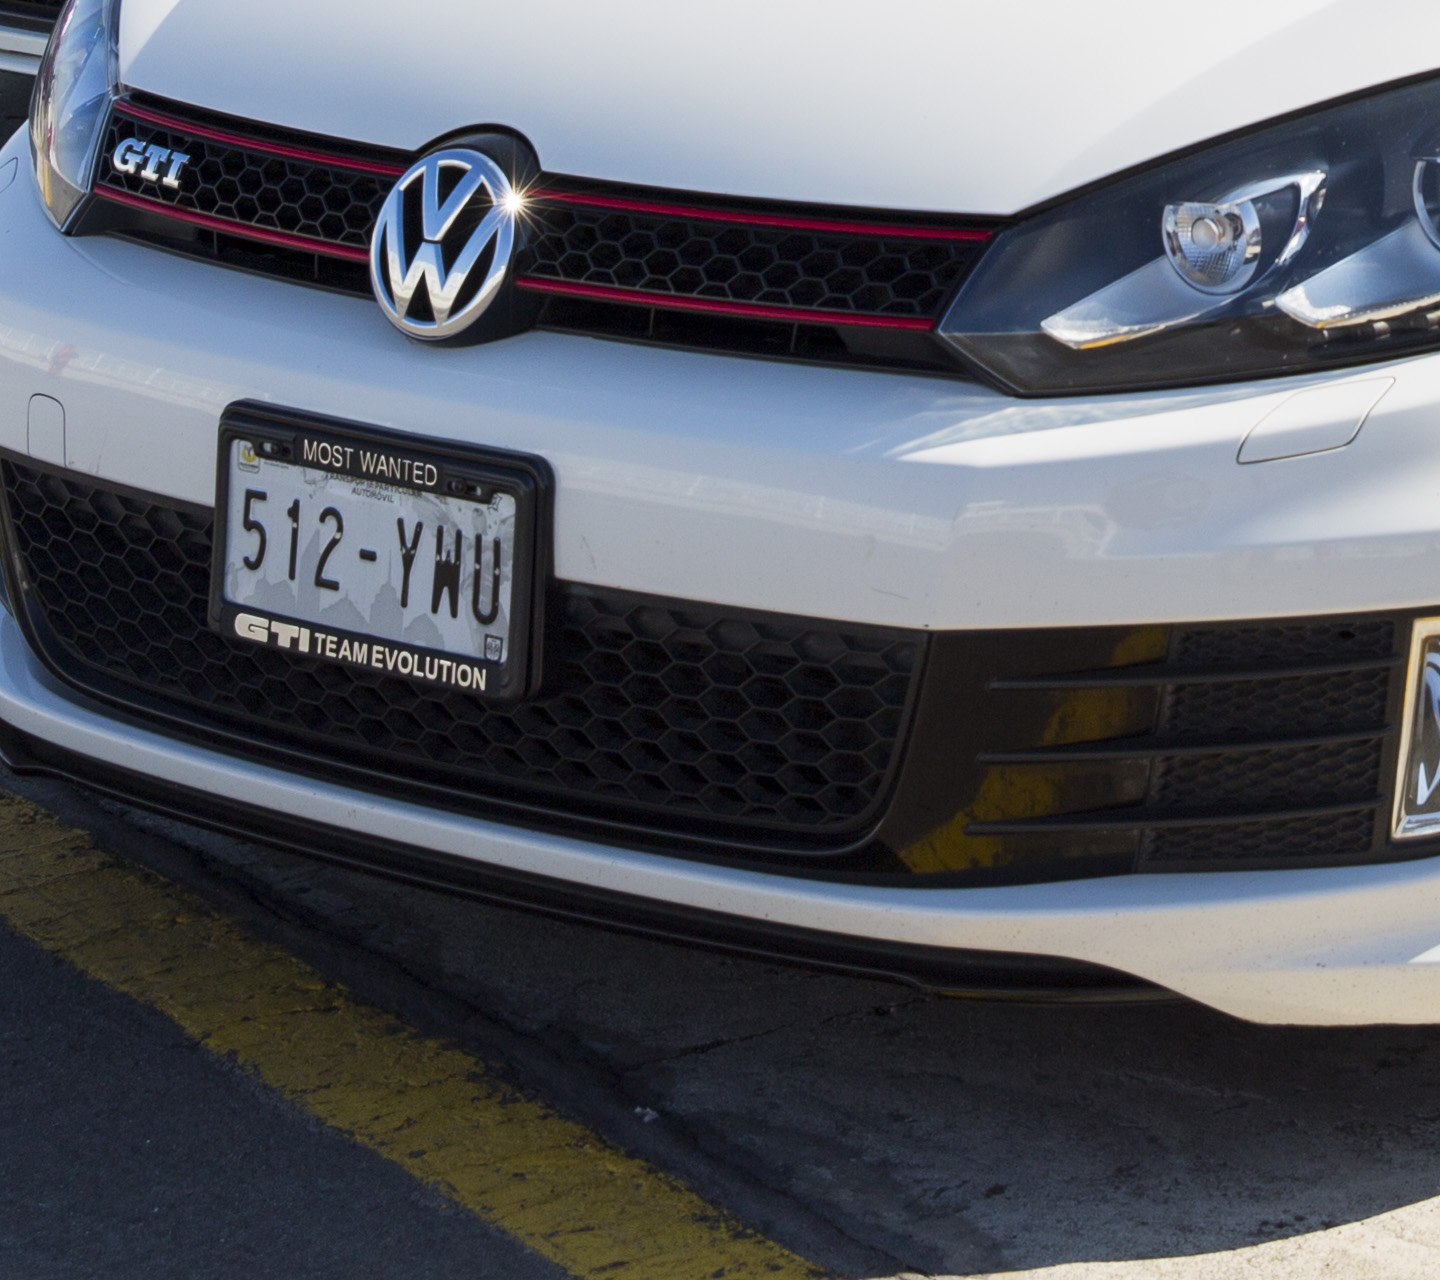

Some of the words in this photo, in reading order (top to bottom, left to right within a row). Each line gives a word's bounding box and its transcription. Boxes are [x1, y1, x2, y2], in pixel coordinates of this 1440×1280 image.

[113, 137, 191, 189] GTI
[370, 148, 517, 341] VW
[303, 439, 354, 470] MOST
[360, 450, 438, 486] WANTED
[242, 487, 502, 626] 512-YWU
[234, 611, 310, 653] GTI
[314, 631, 368, 665] TEAM
[370, 642, 487, 691] EVOLUTION
